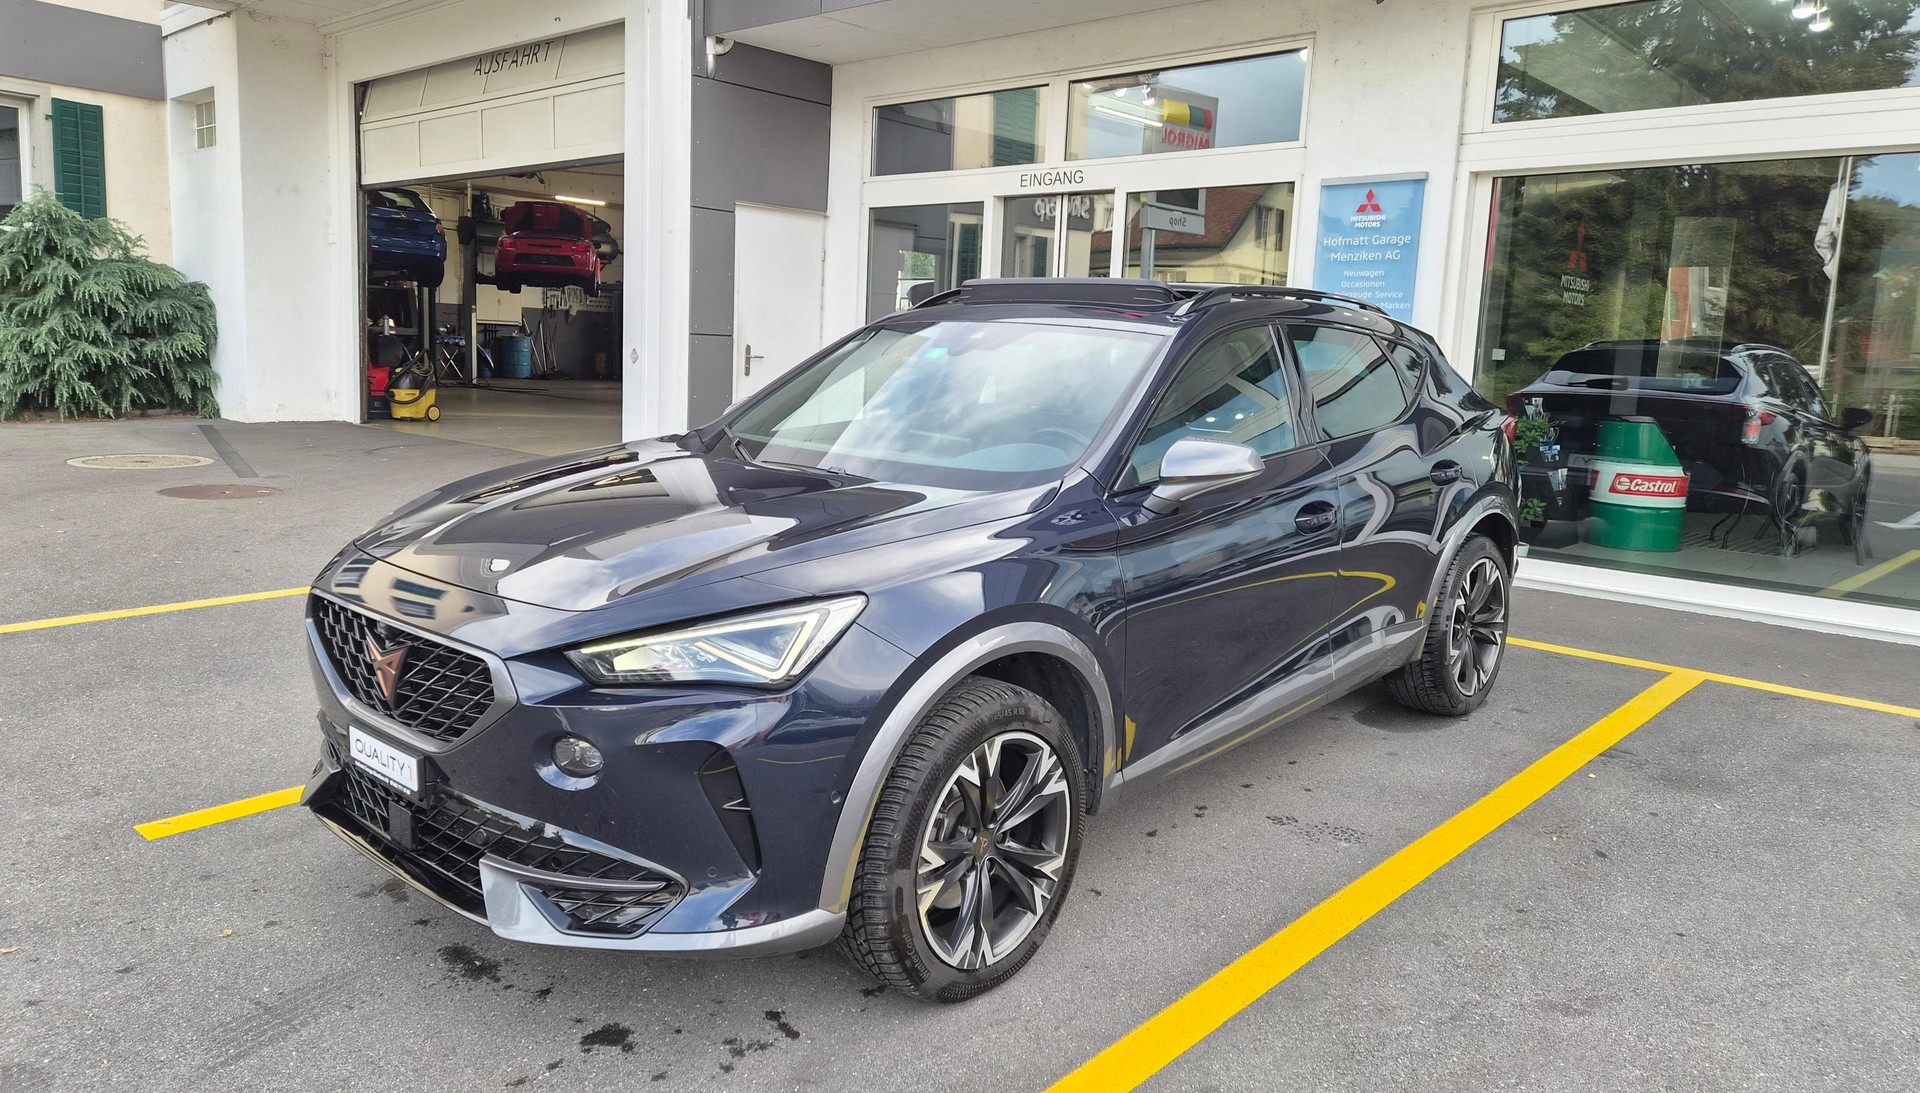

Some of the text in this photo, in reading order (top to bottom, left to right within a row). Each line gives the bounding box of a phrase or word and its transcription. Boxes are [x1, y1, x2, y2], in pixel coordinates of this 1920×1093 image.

[473, 41, 555, 76] AUSFAHRT
[1020, 170, 1084, 188] EINGANG
[1350, 214, 1386, 222] MITSUBISHI
[1323, 234, 1411, 246] Hofmatt Garage
[1330, 250, 1401, 262] Menziken AG
[1343, 270, 1385, 278] Neuwagen
[1561, 274, 1590, 291] MITSUBISHI
[1563, 291, 1585, 305] MOTORS
[1630, 478, 1677, 493] Castrol
[355, 738, 405, 776] QUALITY
